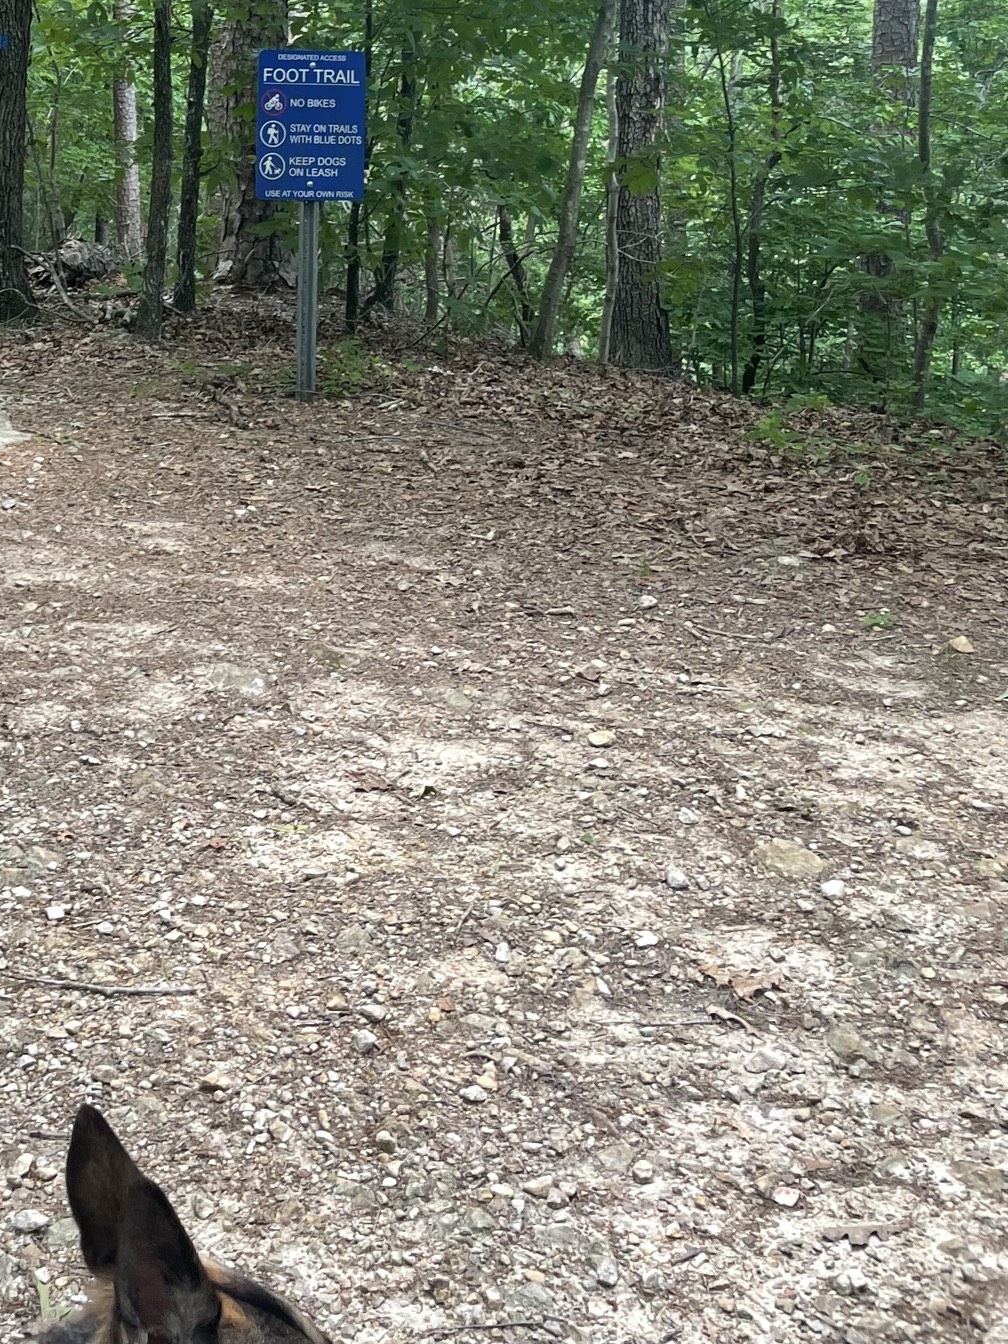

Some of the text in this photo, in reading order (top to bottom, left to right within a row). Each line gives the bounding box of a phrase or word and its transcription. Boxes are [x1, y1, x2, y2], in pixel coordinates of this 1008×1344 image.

[263, 68, 360, 83] FOOT TRAIL
[290, 99, 335, 107] NO BIKES
[290, 124, 358, 133] STAY ON TRAILS
[290, 135, 362, 144] WITH BLUE DOTS
[289, 157, 346, 166] KEEP DOGS
[289, 168, 338, 177] ON LEASH
